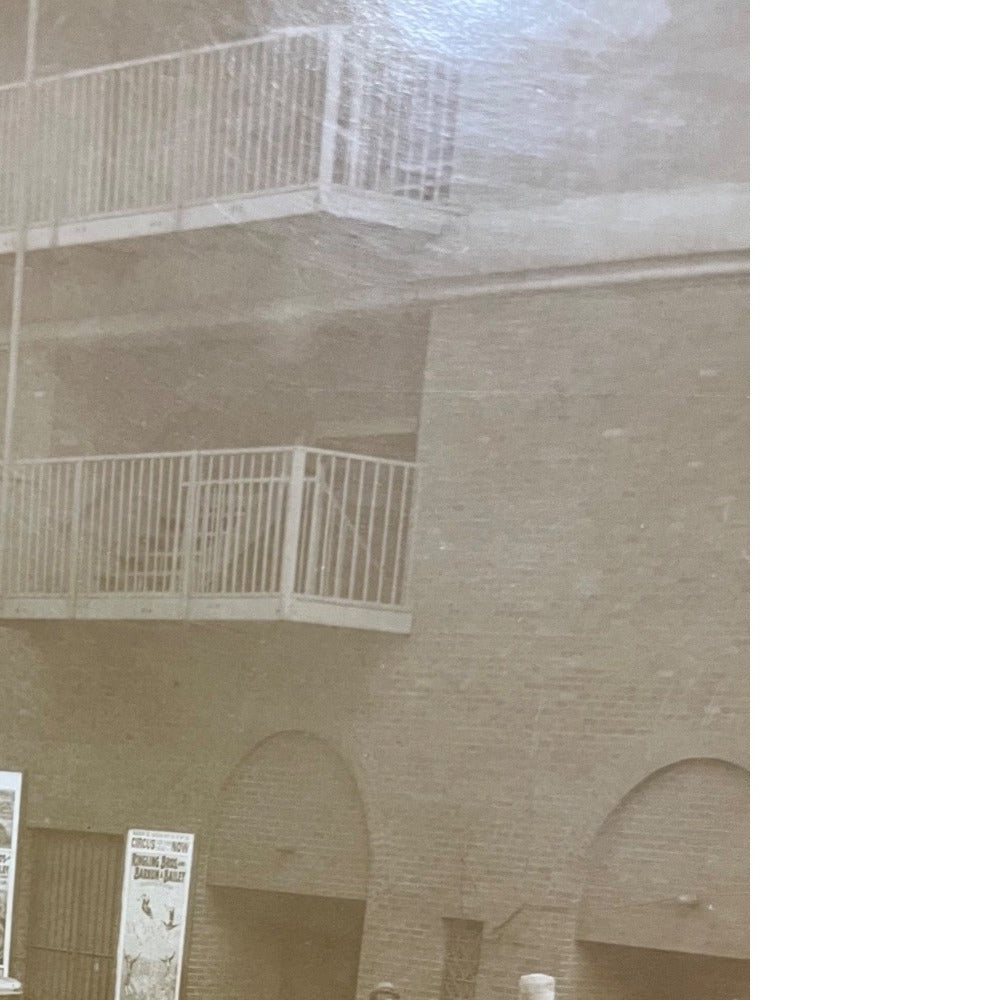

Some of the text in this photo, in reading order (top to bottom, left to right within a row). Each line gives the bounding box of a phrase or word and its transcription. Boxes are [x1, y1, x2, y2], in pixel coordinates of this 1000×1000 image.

[171, 841, 190, 853] NOW
[131, 853, 159, 868] RINGLING
[163, 870, 186, 883] BAILEY
